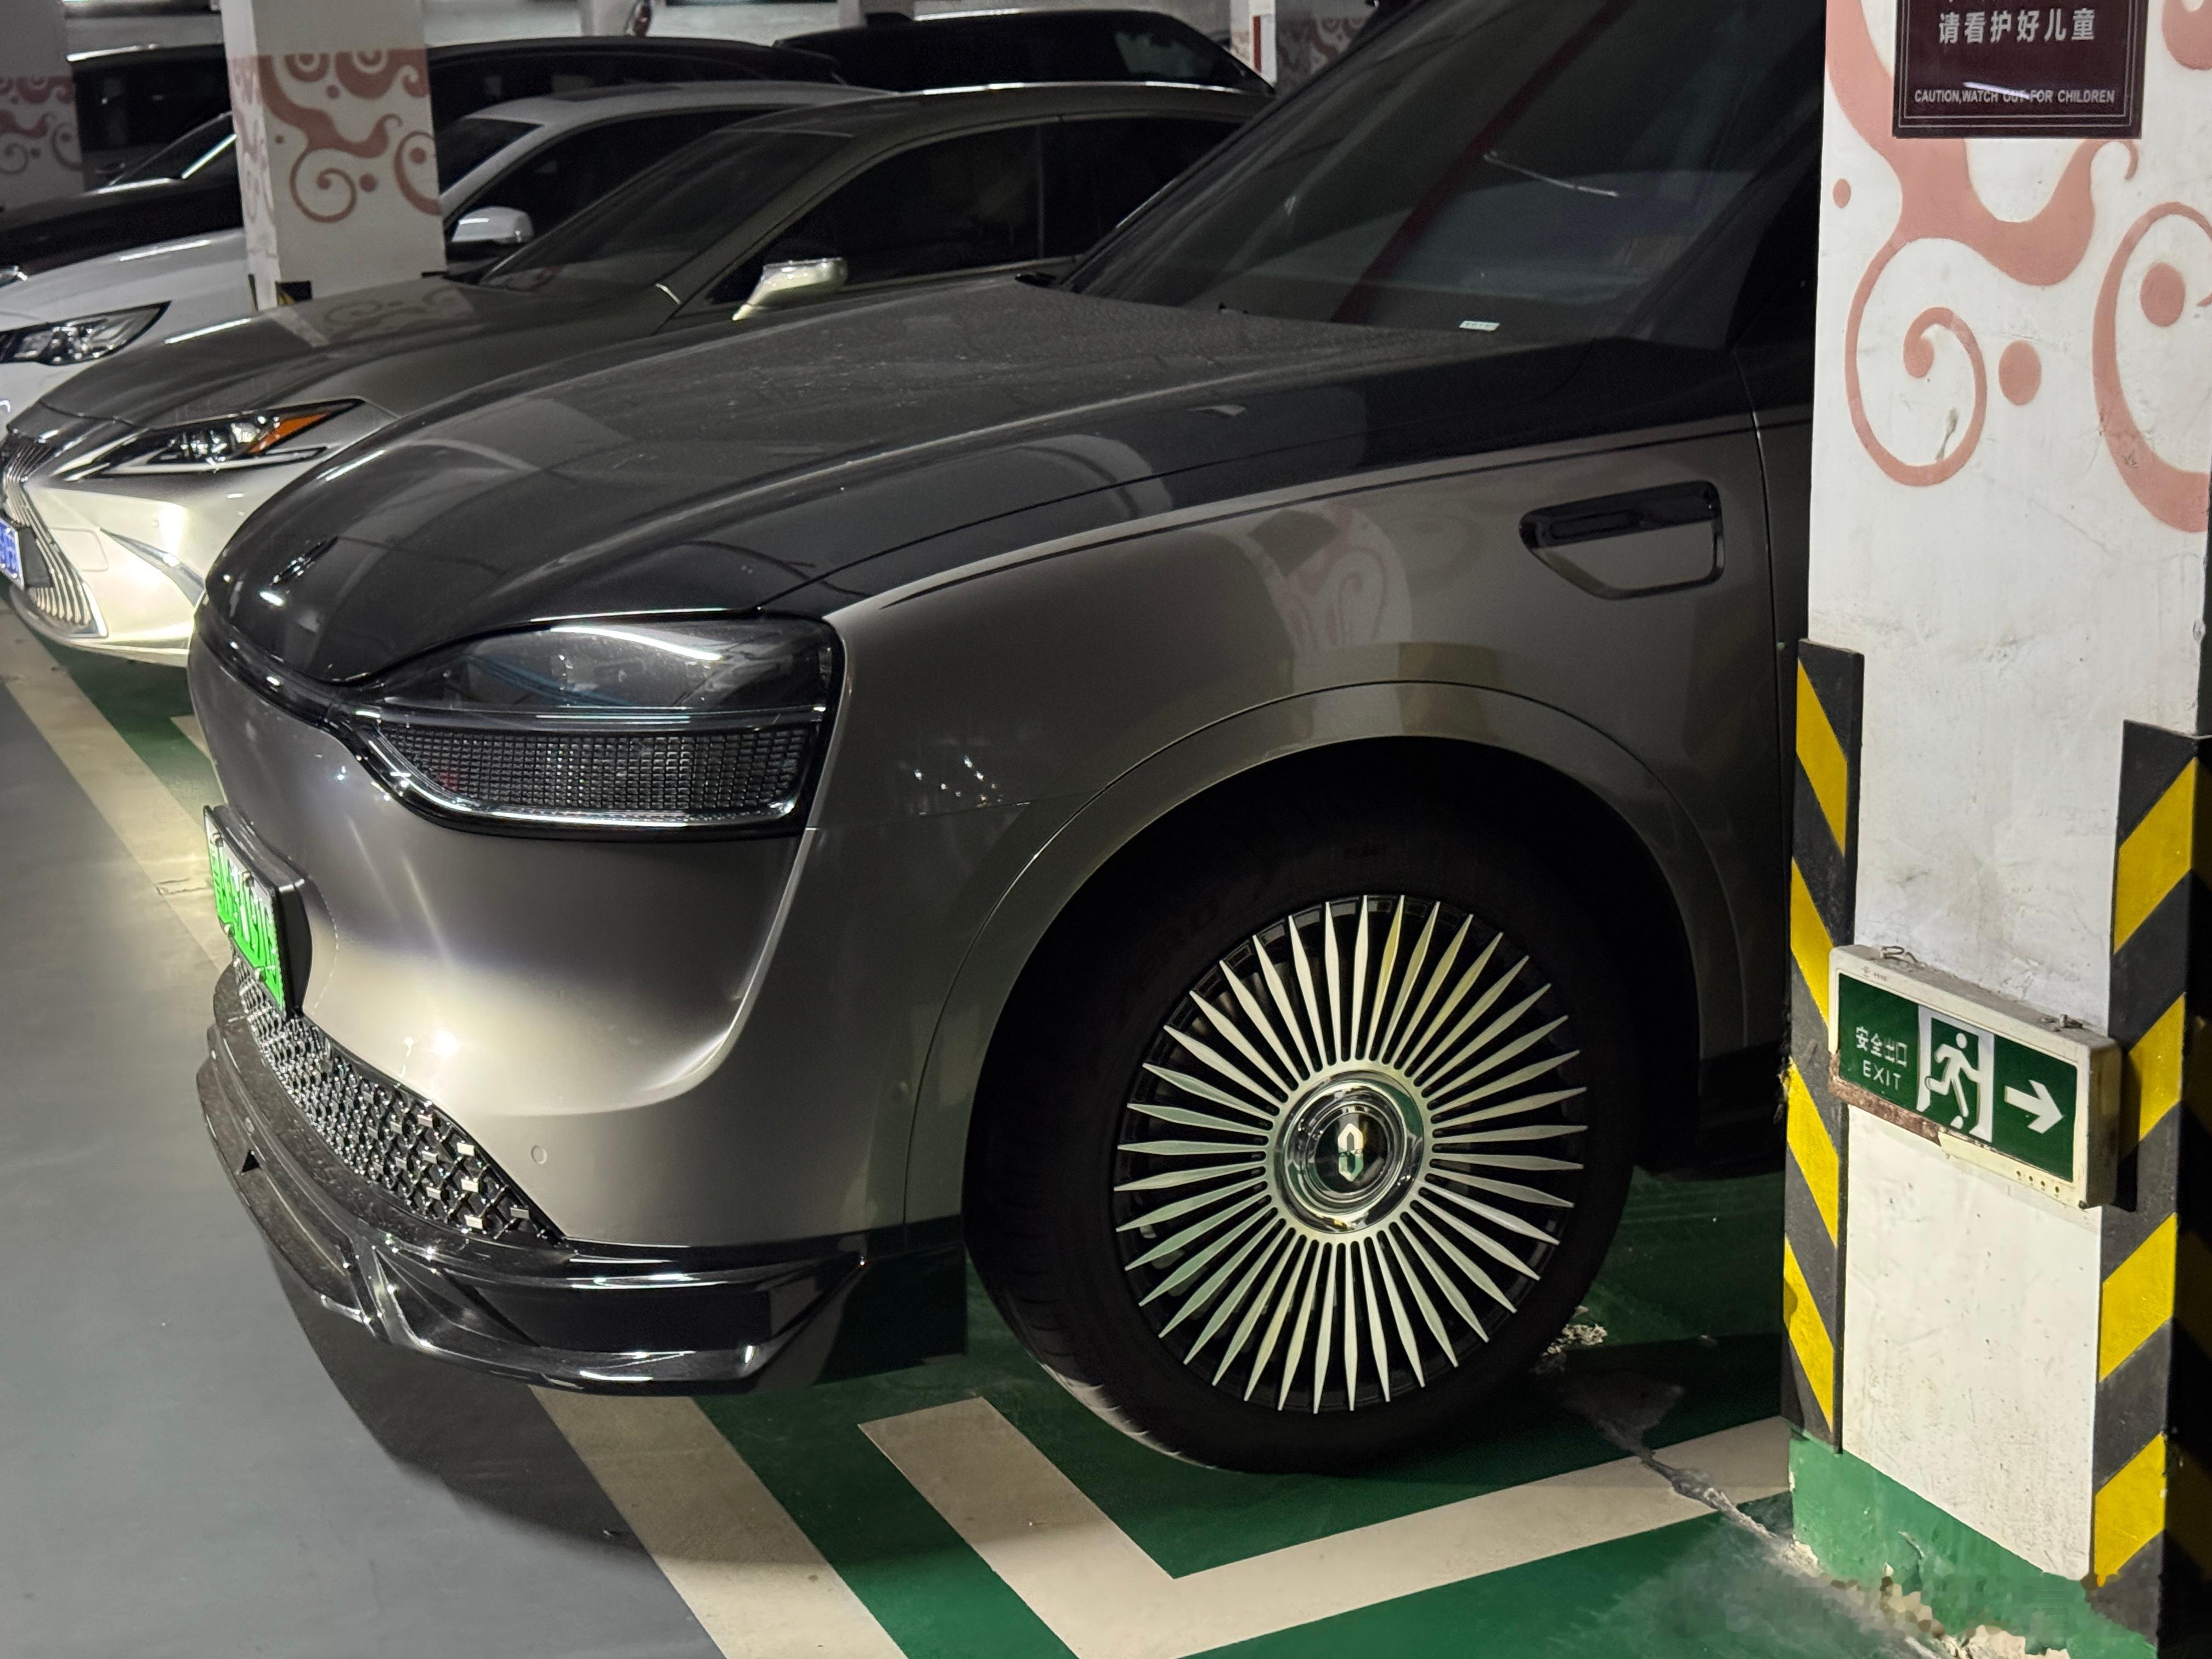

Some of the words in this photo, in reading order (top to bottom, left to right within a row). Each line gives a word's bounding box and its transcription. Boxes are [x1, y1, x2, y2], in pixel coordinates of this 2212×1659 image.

[1939, 8, 2095, 44] 请看护好儿童
[2030, 89, 2053, 104] FOR
[2057, 89, 2115, 104] CHILDREN
[1855, 1026, 1908, 1067] 安全出口
[1863, 1059, 1901, 1091] EXIT
